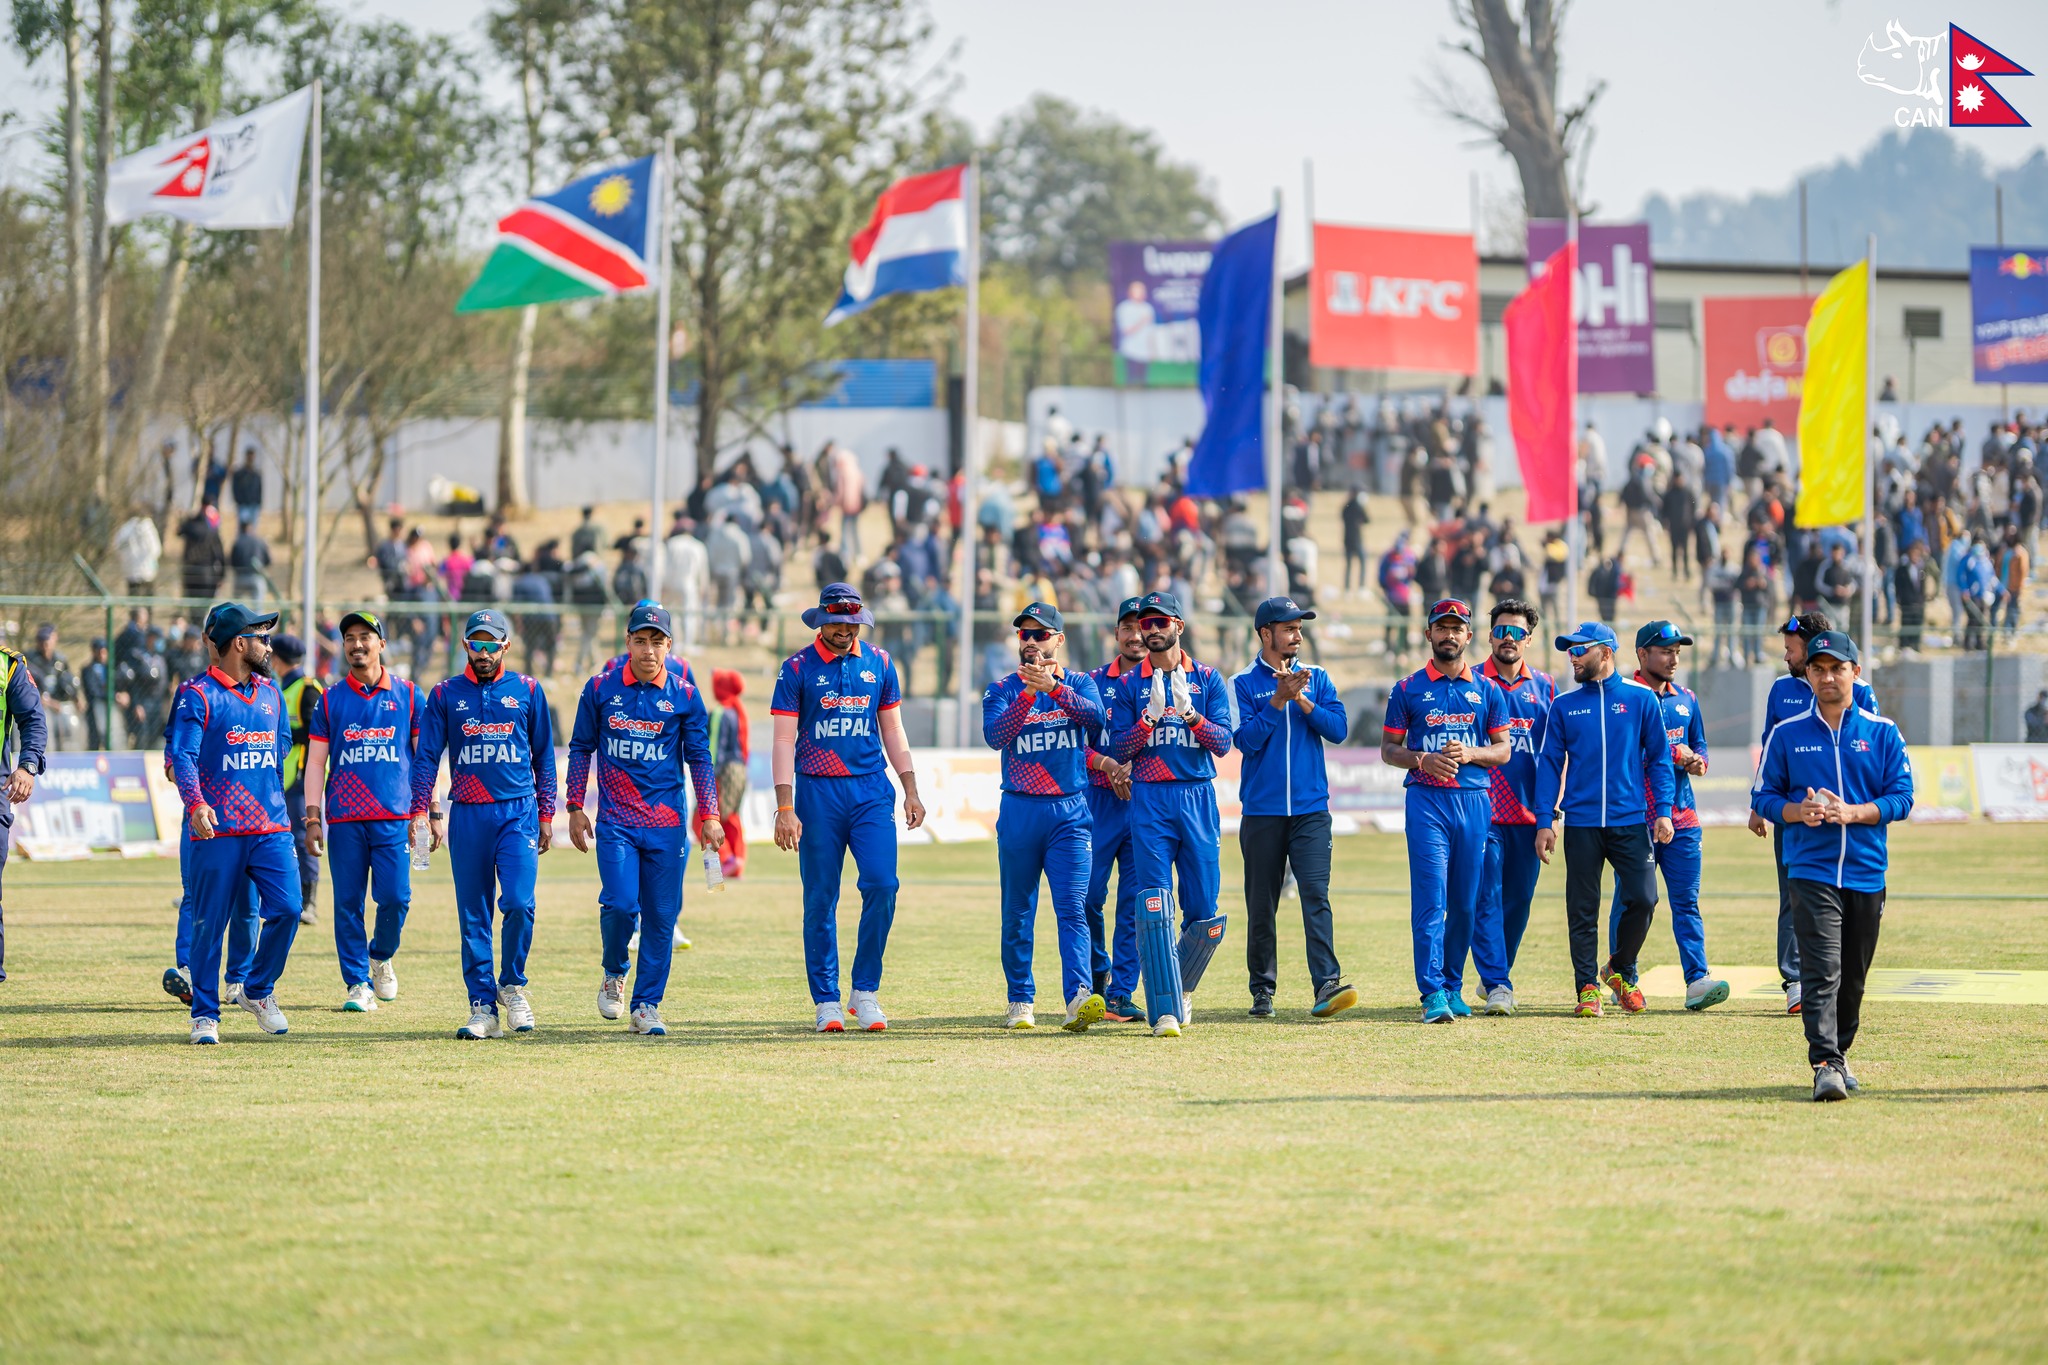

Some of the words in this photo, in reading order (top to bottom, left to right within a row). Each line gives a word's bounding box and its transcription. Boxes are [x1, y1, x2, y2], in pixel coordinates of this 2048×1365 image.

[1368, 275, 1463, 321] KFC
[820, 695, 871, 709] Second
[1426, 712, 1475, 727] Second
[1568, 708, 1591, 716] KELME
[462, 721, 515, 736] Second
[608, 716, 664, 734] Second
[815, 718, 870, 739] NEPAL
[226, 730, 275, 745] Second
[343, 726, 396, 742] Second
[339, 746, 399, 765] NEPAL
[458, 744, 521, 764] NEPAL
[607, 738, 668, 760] NEPAL
[1147, 900, 1161, 909] SS
